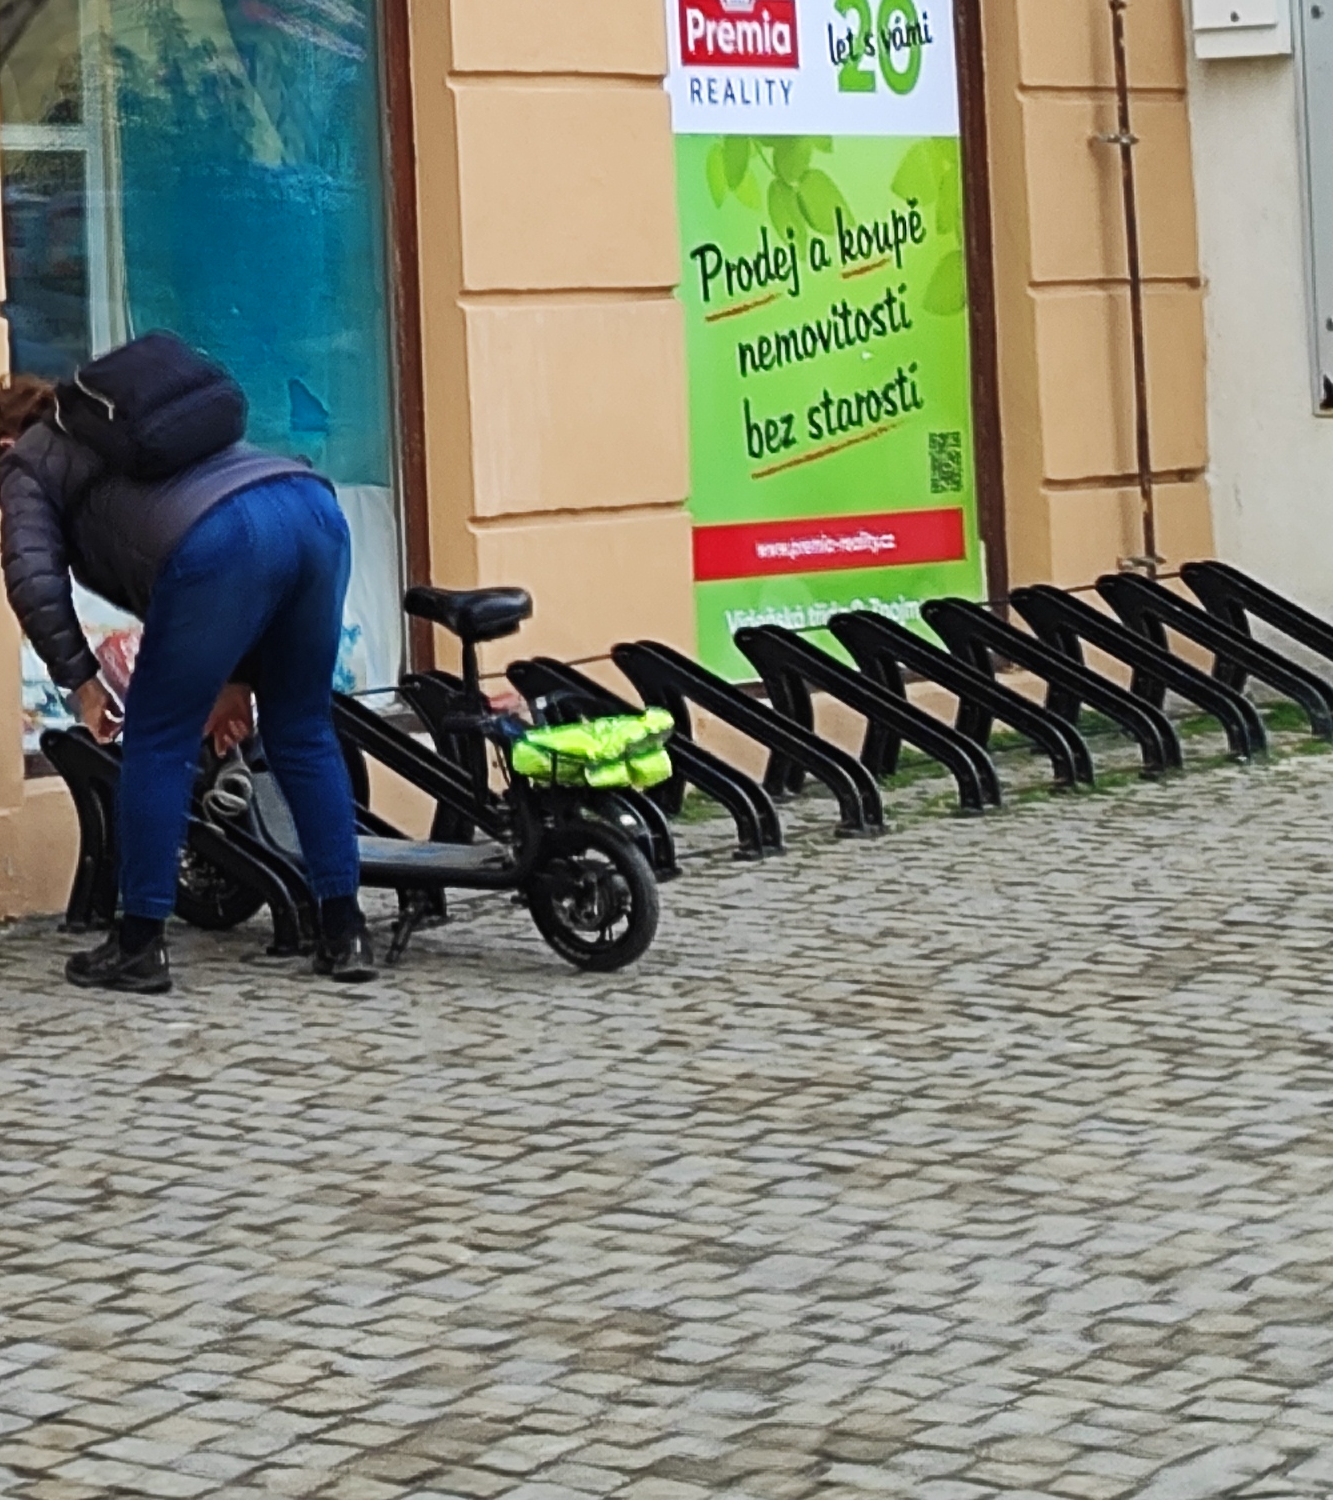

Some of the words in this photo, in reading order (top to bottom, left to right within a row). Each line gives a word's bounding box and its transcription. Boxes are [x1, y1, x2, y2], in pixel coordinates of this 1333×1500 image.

[686, 7, 793, 56] Premia
[828, 22, 858, 66] let
[864, 31, 876, 56] s
[881, 11, 933, 55] vámi
[690, 77, 794, 106] REALITY
[690, 226, 801, 301] Prodej
[810, 241, 831, 270] a
[836, 199, 925, 269] koupě
[744, 397, 796, 459] bez
